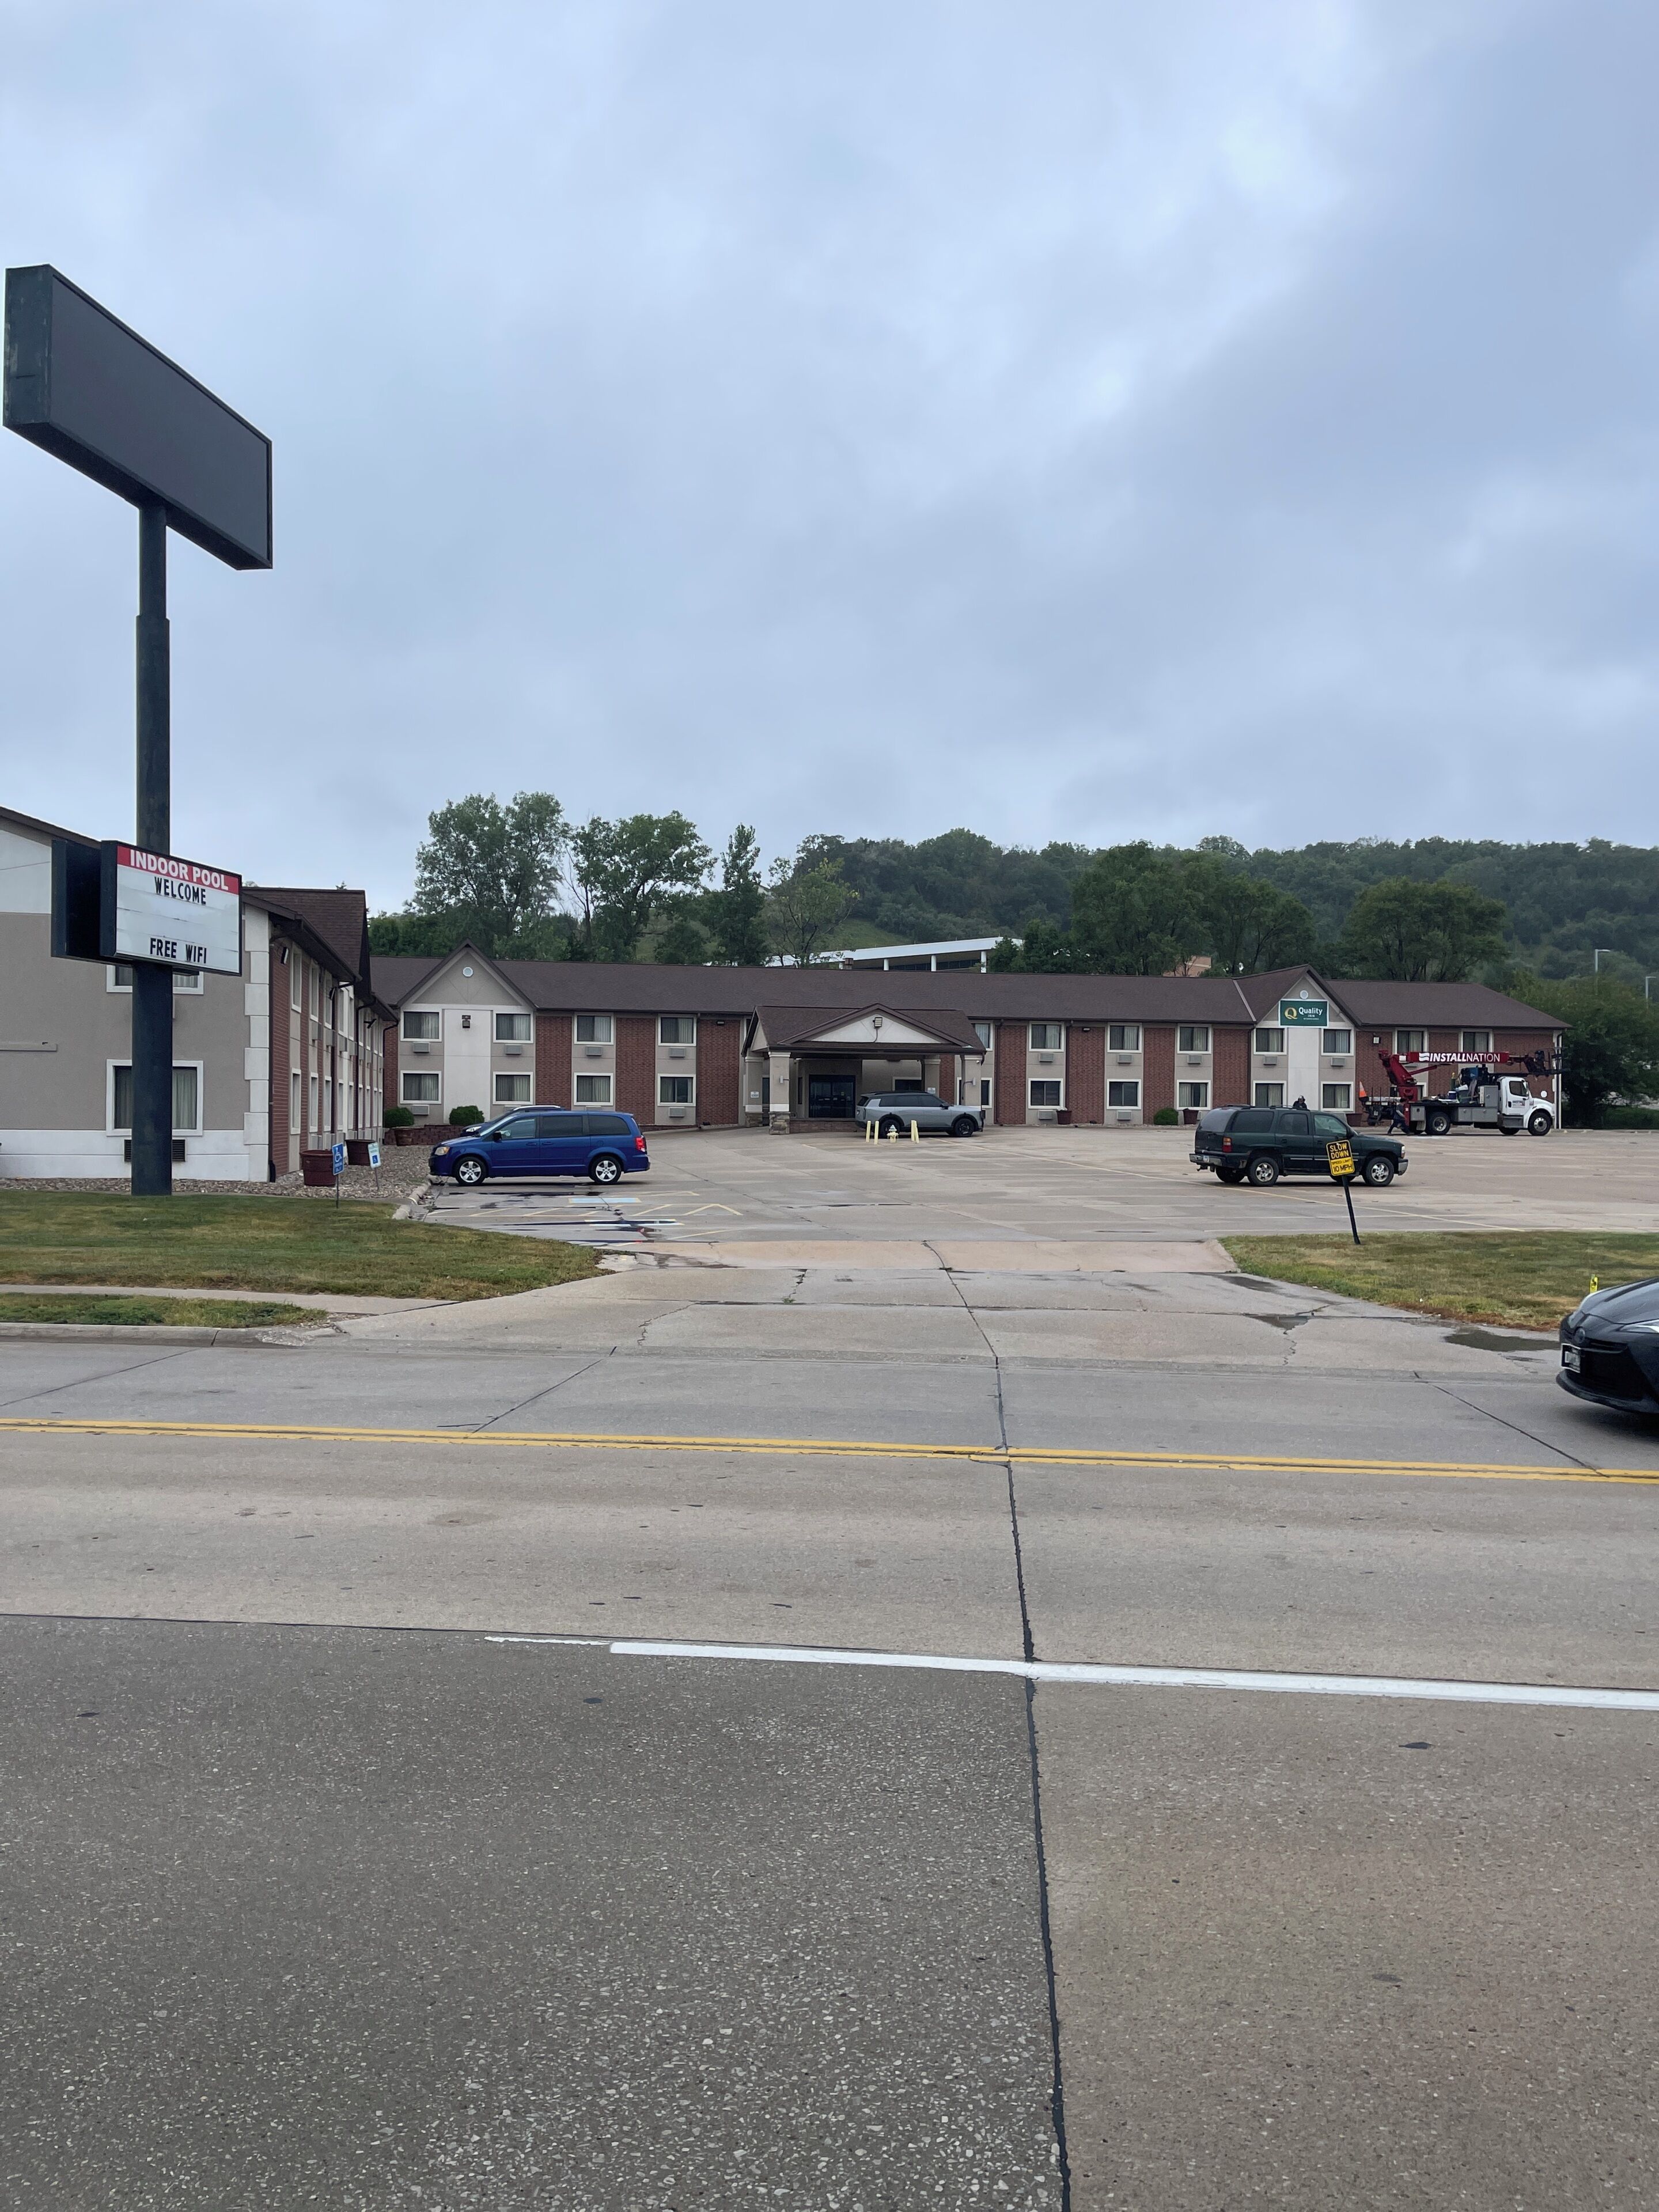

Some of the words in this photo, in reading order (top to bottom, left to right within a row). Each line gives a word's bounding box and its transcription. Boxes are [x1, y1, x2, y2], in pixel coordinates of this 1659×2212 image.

[130, 849, 190, 881] INDOOR
[192, 866, 229, 891] POOL
[154, 876, 206, 905] WELCOME
[150, 937, 177, 959] FREE
[185, 944, 207, 964] WIFI
[1298, 1007, 1323, 1016] Quality
[1429, 1052, 1500, 1062] INSTALLNATION
[1330, 1143, 1347, 1152] SLOW
[1331, 1150, 1349, 1159] DOWN
[1340, 1164, 1353, 1172] MPH
